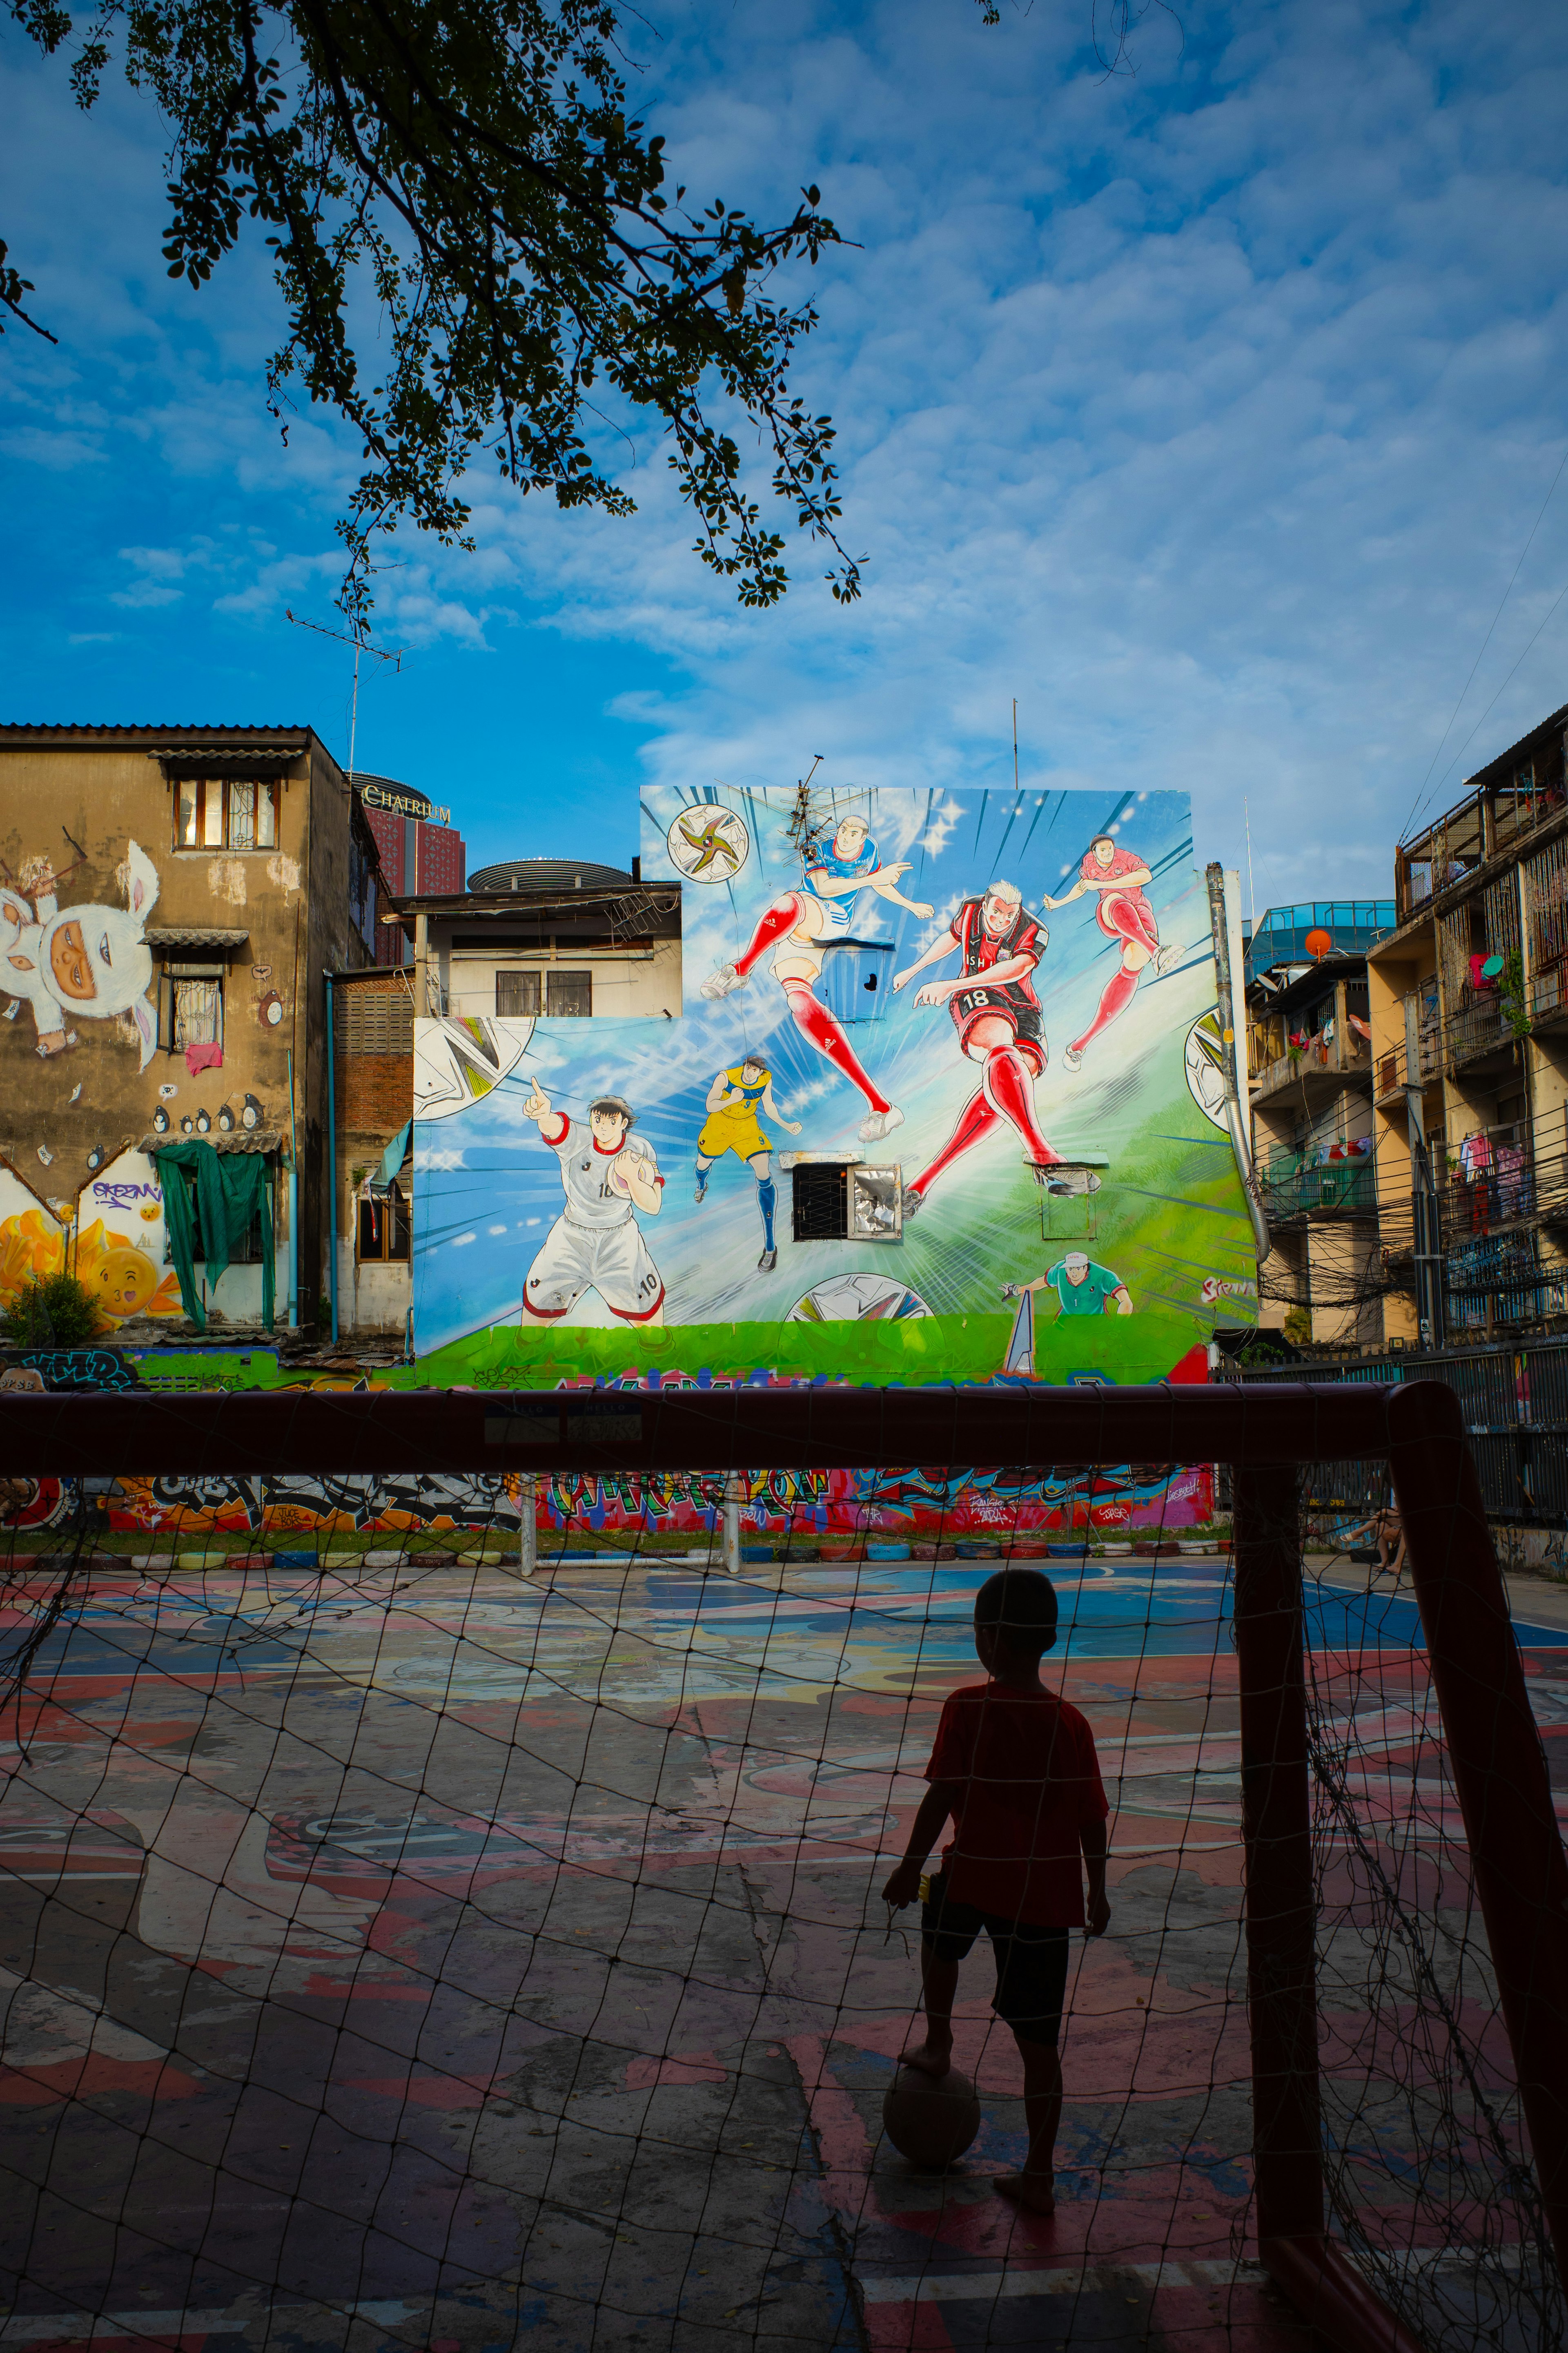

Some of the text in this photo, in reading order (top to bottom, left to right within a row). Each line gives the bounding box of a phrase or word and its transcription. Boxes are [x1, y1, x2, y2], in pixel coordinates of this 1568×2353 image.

[365, 785, 450, 823] CHATRIUM
[964, 990, 989, 1010] 18
[744, 1100, 751, 1109] 9
[758, 1136, 765, 1145] 9
[599, 1183, 613, 1198] 10
[640, 1274, 657, 1296] 10
[1074, 1298, 1077, 1307] 1
